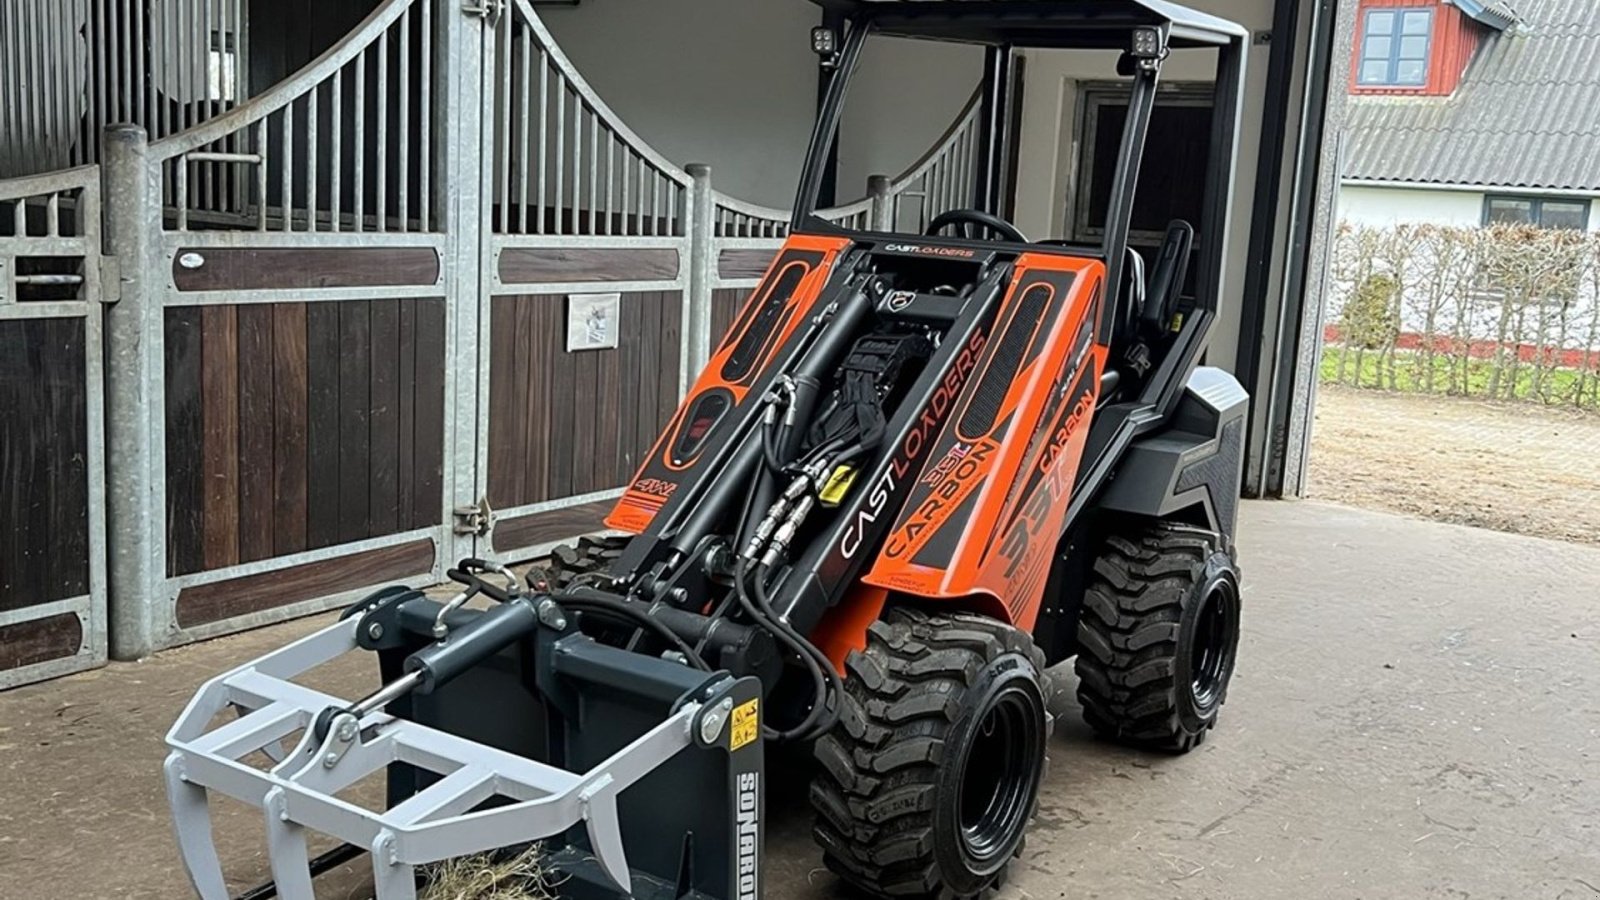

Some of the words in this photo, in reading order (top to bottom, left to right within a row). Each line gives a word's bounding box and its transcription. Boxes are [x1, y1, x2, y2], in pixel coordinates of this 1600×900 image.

[885, 243, 975, 257] CASTLOADERS
[840, 327, 987, 560] CASTLOADERS
[1039, 388, 1095, 474] CARBON
[885, 441, 996, 558] CARBON
